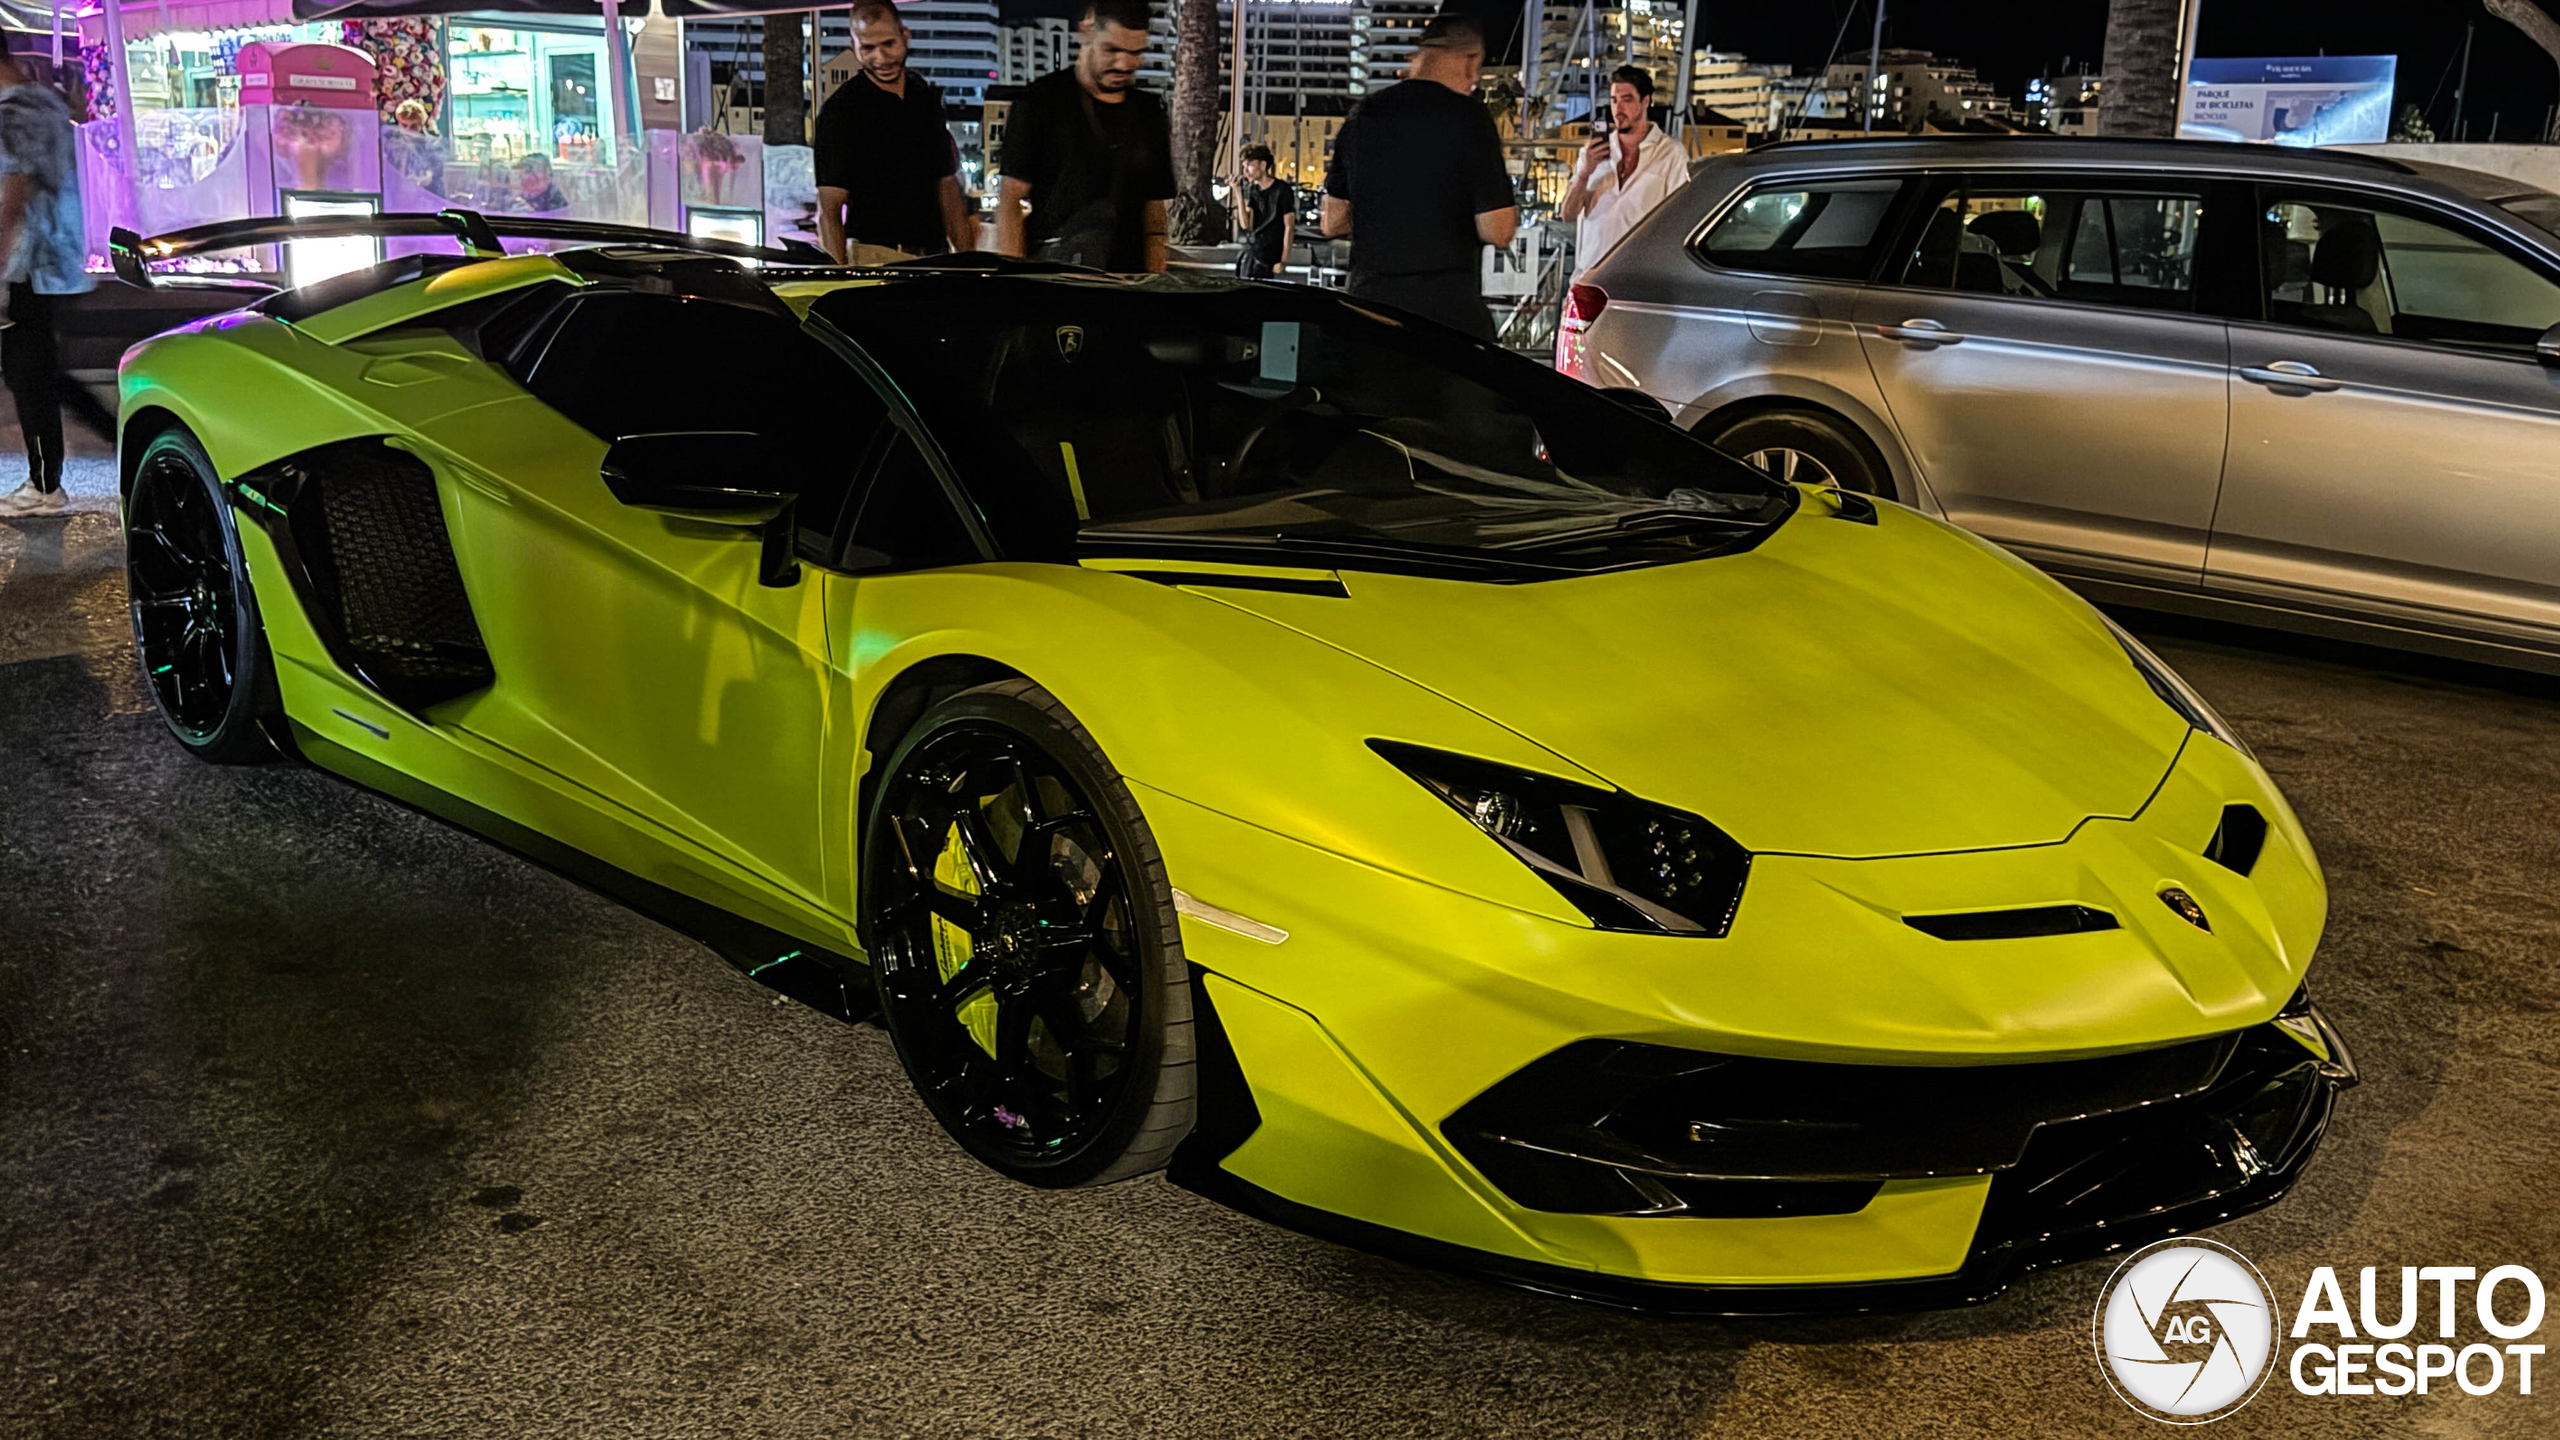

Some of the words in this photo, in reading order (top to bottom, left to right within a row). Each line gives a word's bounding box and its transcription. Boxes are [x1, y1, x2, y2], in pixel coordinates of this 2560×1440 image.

[2197, 90, 2230, 99] PARQUE
[2195, 101, 2206, 109] DE
[2209, 101, 2254, 109] BICICLETAS
